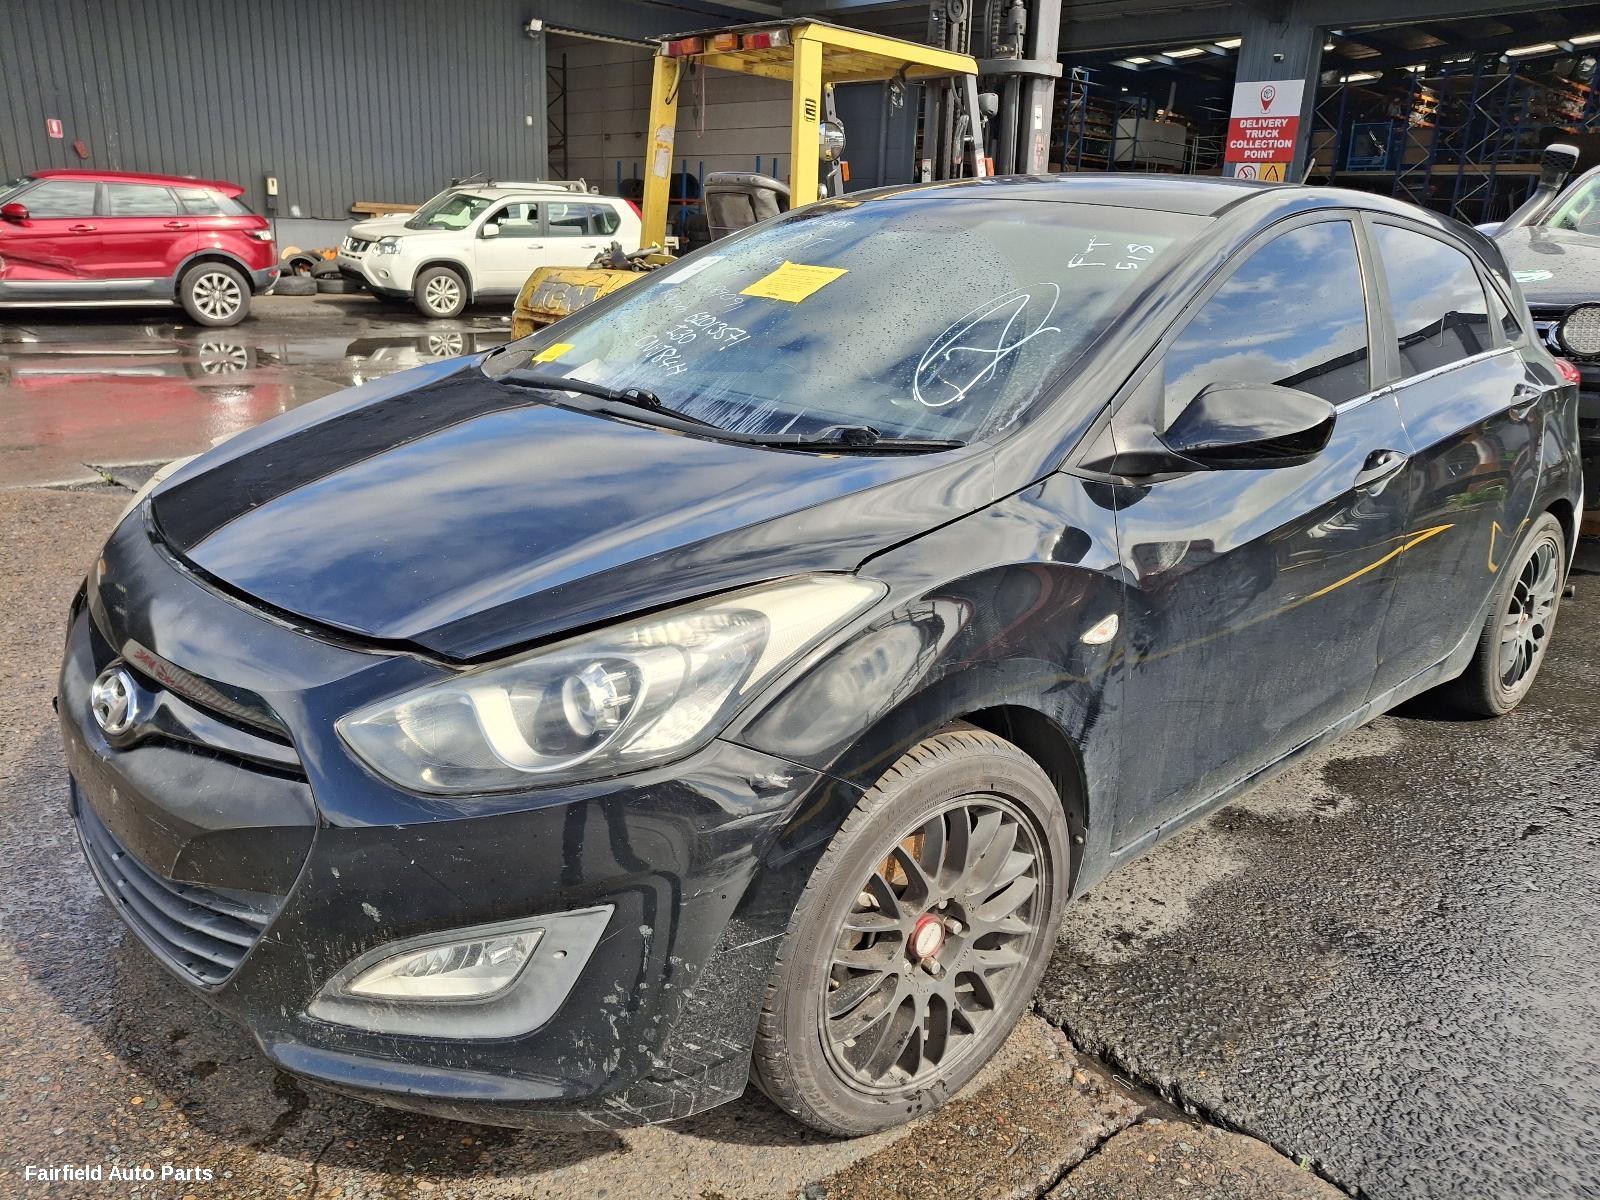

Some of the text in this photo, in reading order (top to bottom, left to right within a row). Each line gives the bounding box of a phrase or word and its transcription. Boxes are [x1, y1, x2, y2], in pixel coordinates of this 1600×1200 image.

[1239, 119, 1288, 128] DELIVERY
[1245, 129, 1280, 138] TRUCK
[1230, 139, 1293, 149] COLLECTION
[1244, 150, 1275, 159] POINT
